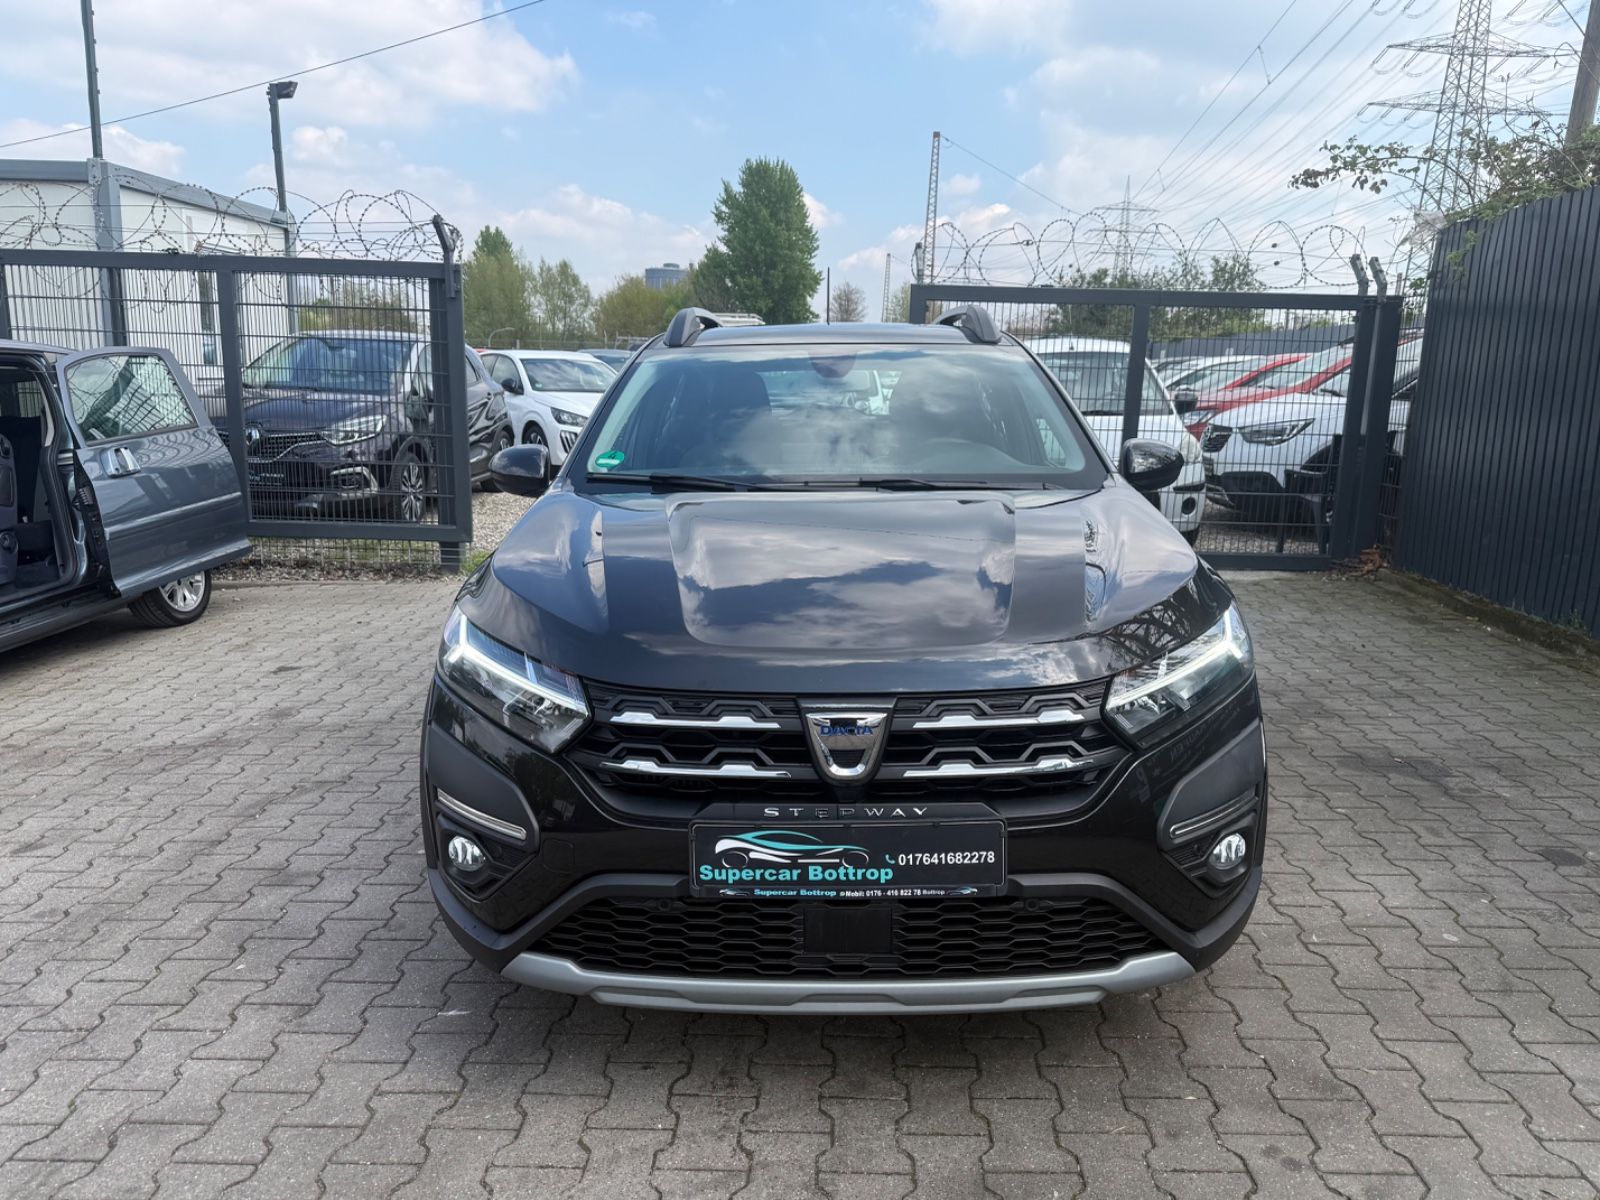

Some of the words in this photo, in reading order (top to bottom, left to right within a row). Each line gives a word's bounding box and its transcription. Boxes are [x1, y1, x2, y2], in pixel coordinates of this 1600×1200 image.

[819, 725, 873, 737] DACIA
[763, 807, 928, 818] STEPWAY
[898, 851, 995, 866] 017641682278
[699, 865, 802, 883] Supercar
[808, 865, 894, 883] Bottrop
[753, 889, 797, 897] Supercar
[800, 889, 837, 897] Bottrop
[866, 889, 882, 897] 0176
